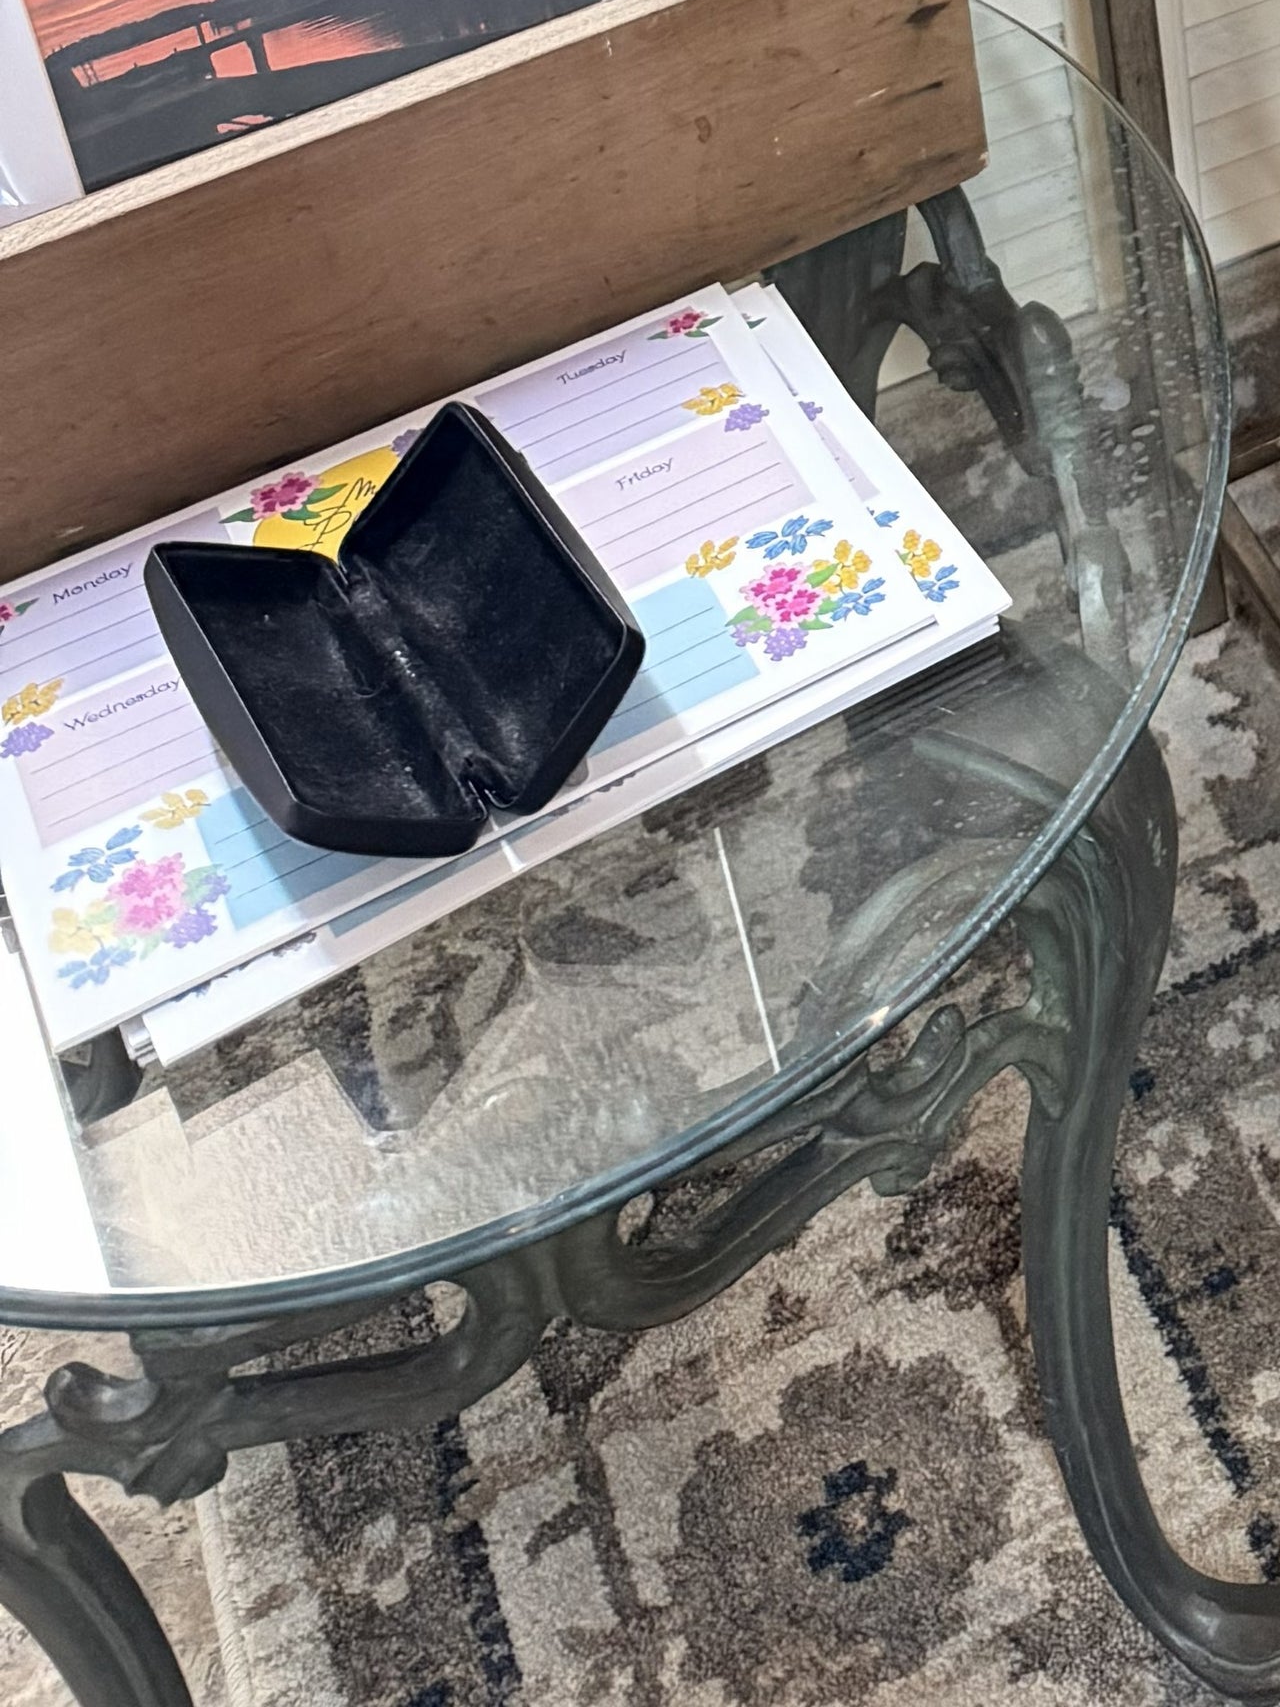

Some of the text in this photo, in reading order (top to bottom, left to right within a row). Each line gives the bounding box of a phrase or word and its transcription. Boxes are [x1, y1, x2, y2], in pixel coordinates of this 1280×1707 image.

[556, 349, 627, 385] Tuesday
[615, 457, 674, 491] Friday
[52, 562, 134, 605] Monday
[63, 675, 181, 731] Wednesday
